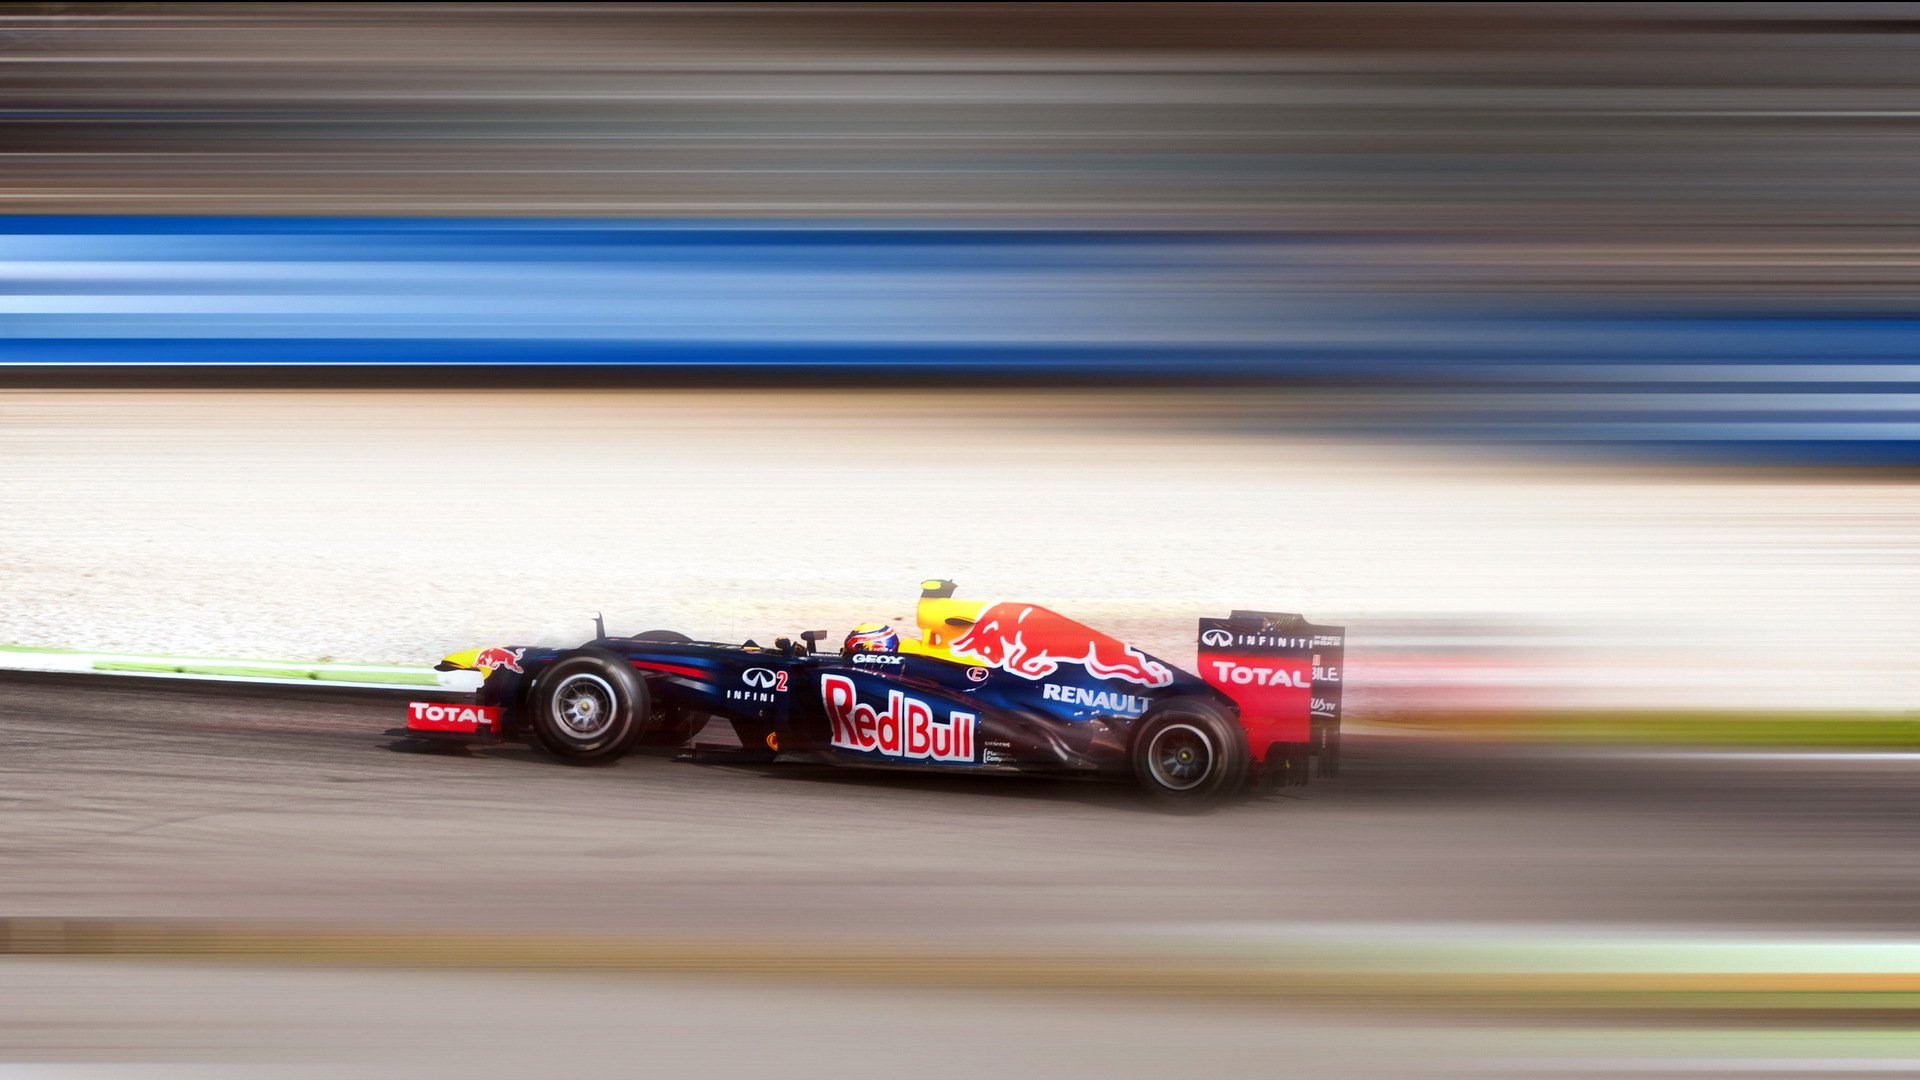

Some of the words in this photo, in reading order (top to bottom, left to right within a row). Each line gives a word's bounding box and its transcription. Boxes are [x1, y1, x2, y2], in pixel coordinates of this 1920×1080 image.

[1238, 634, 1313, 649] INFINITI
[852, 653, 905, 665] GEOX
[776, 671, 788, 692] 2
[1212, 661, 1311, 688] TOTAL
[727, 689, 774, 702] INFINI
[1043, 683, 1154, 714] RENAULT
[409, 702, 492, 724] TOTAL
[823, 675, 902, 754] Red
[905, 700, 974, 761] Bull
